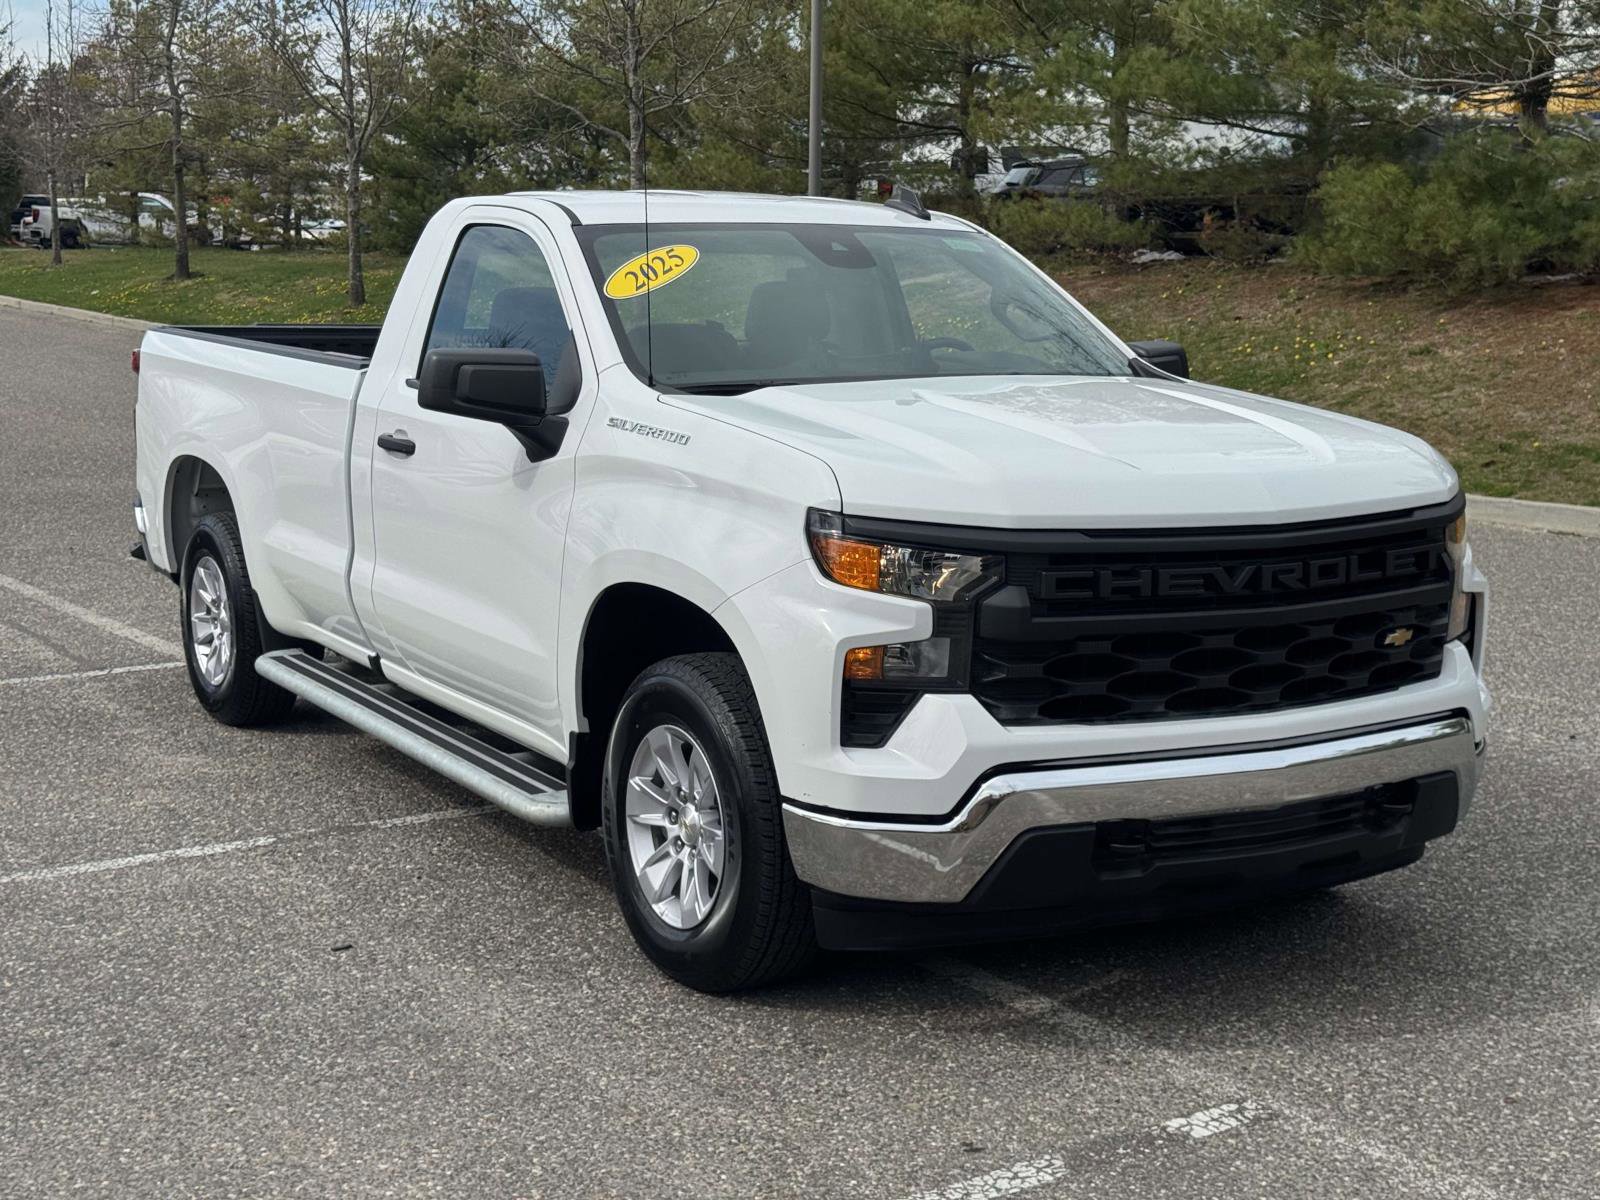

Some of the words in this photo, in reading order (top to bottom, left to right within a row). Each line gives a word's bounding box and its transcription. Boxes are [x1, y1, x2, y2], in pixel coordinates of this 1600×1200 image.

[624, 248, 685, 291] 2025
[606, 416, 691, 446] SILVERADO
[1039, 542, 1443, 599] CHEVROLET
